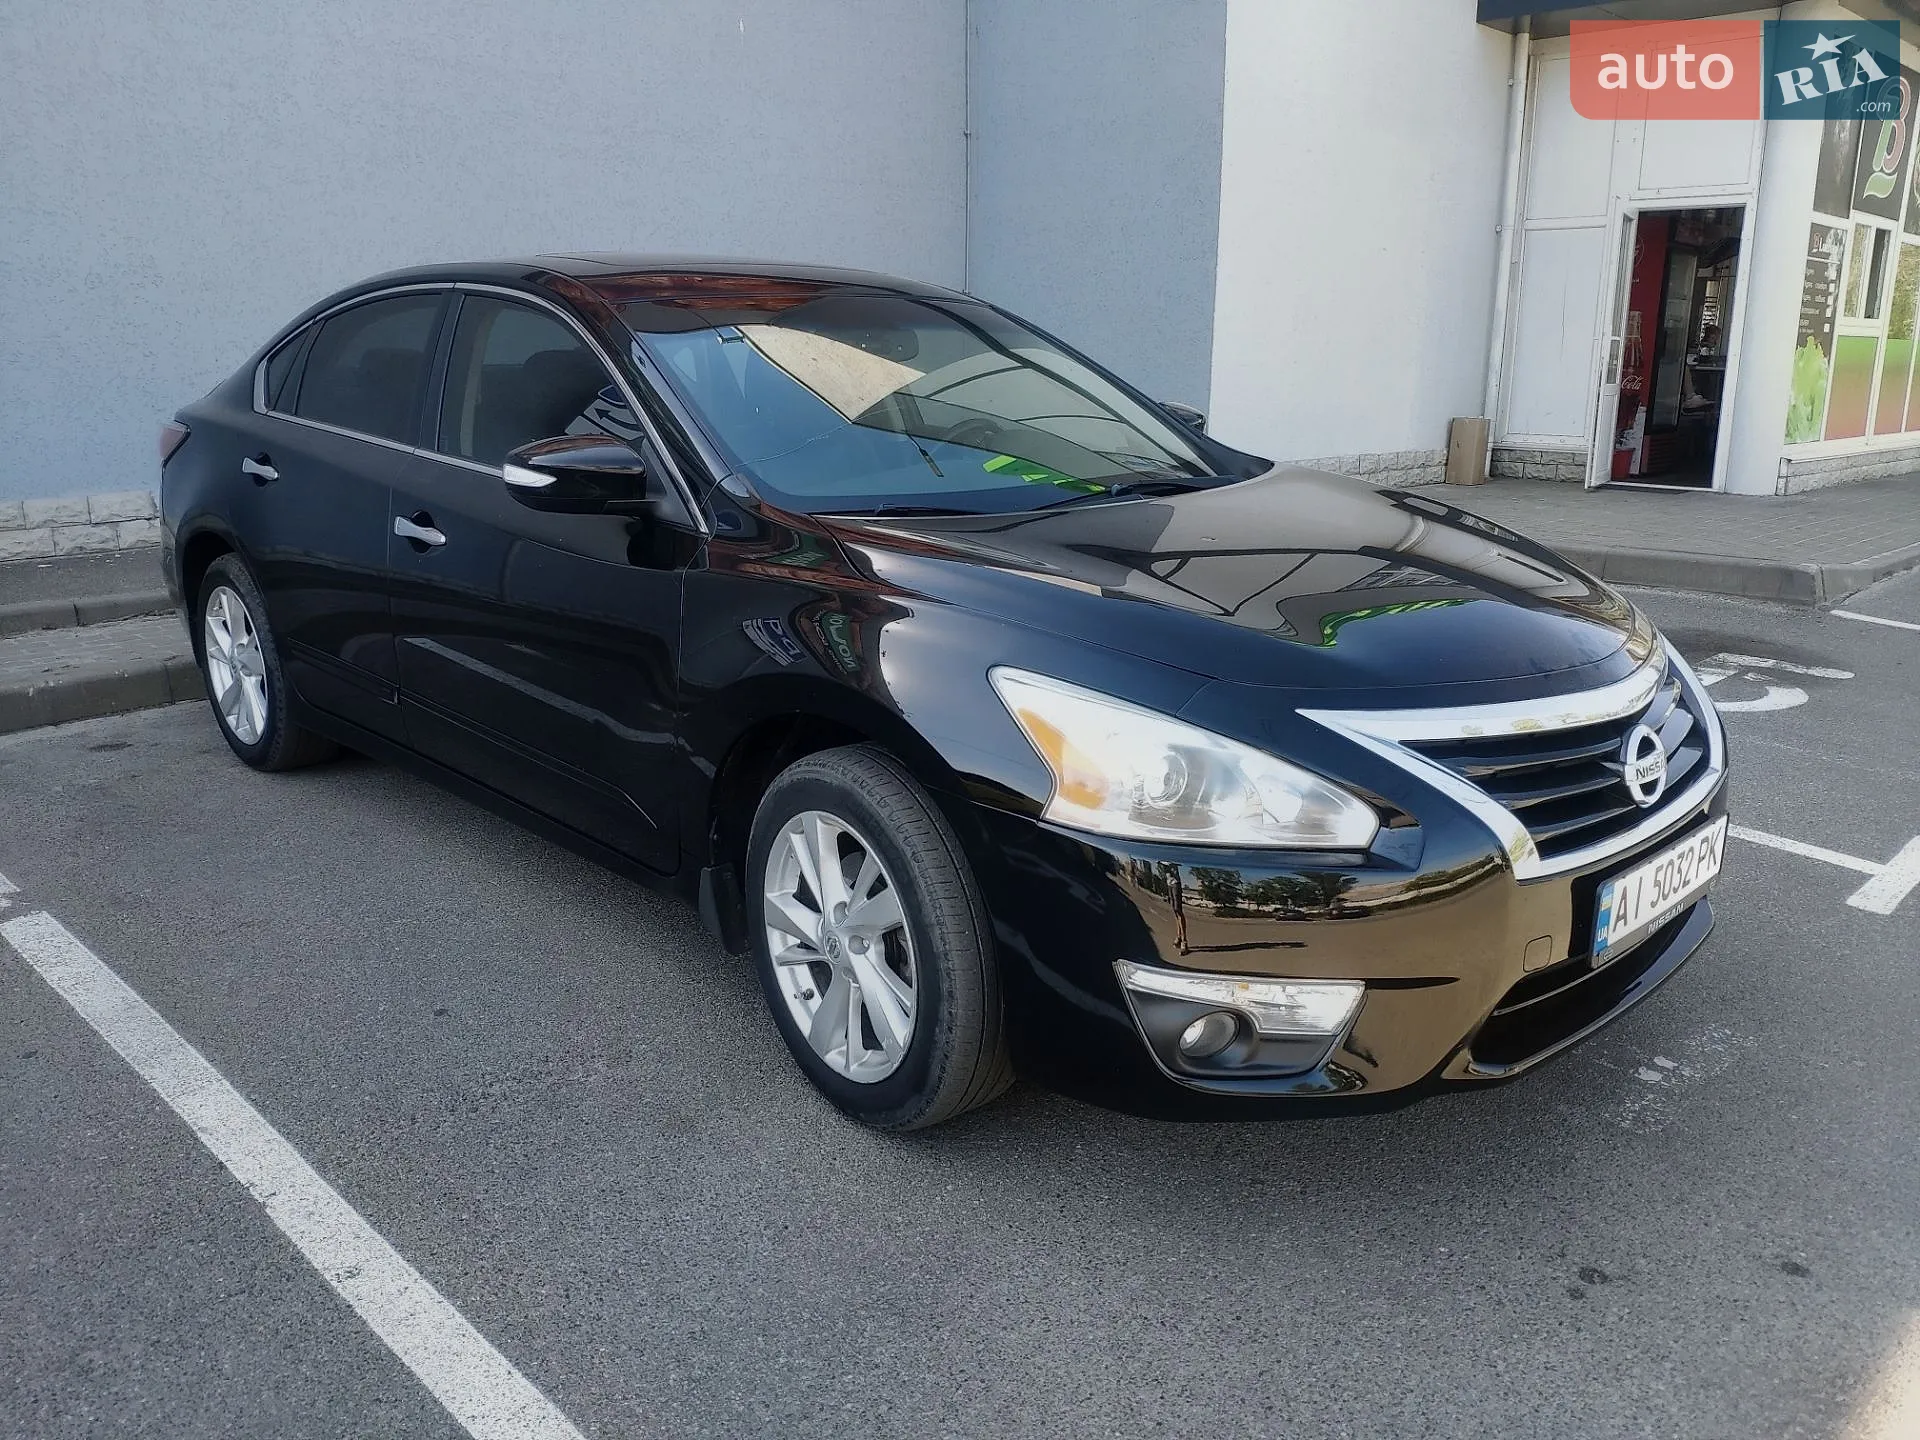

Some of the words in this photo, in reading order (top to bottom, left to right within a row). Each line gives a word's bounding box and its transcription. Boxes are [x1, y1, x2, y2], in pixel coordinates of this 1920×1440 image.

[1621, 375, 1643, 390] Cola
[1636, 757, 1667, 780] NISS
[1613, 876, 1643, 933] AI
[1650, 846, 1694, 909] 5032
[1696, 827, 1722, 879] PK
[1647, 903, 1685, 935] NISSAN
[1597, 925, 1608, 941] UA
